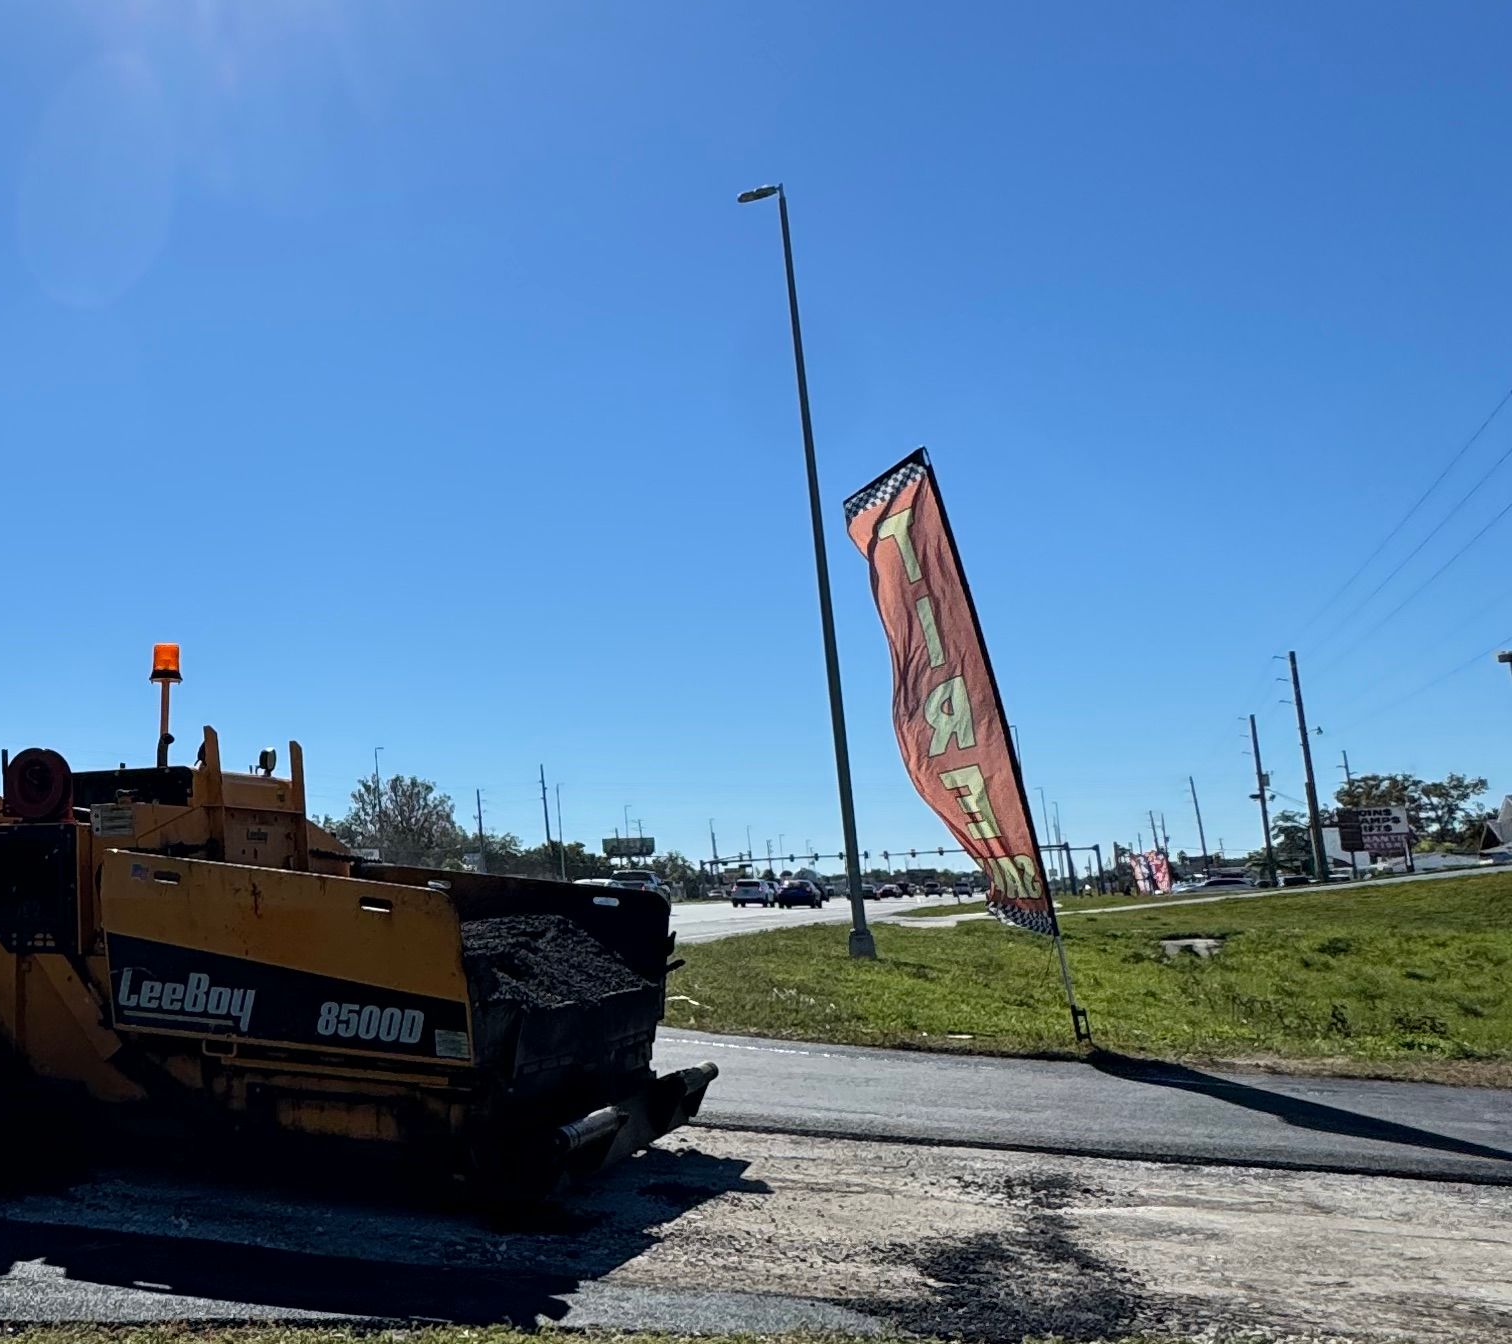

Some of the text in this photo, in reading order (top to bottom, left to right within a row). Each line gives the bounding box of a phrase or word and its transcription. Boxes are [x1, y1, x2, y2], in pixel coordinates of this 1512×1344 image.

[1358, 808, 1393, 817] OINS
[118, 967, 256, 1032] LeeBoy
[317, 1001, 425, 1044] 8500D
